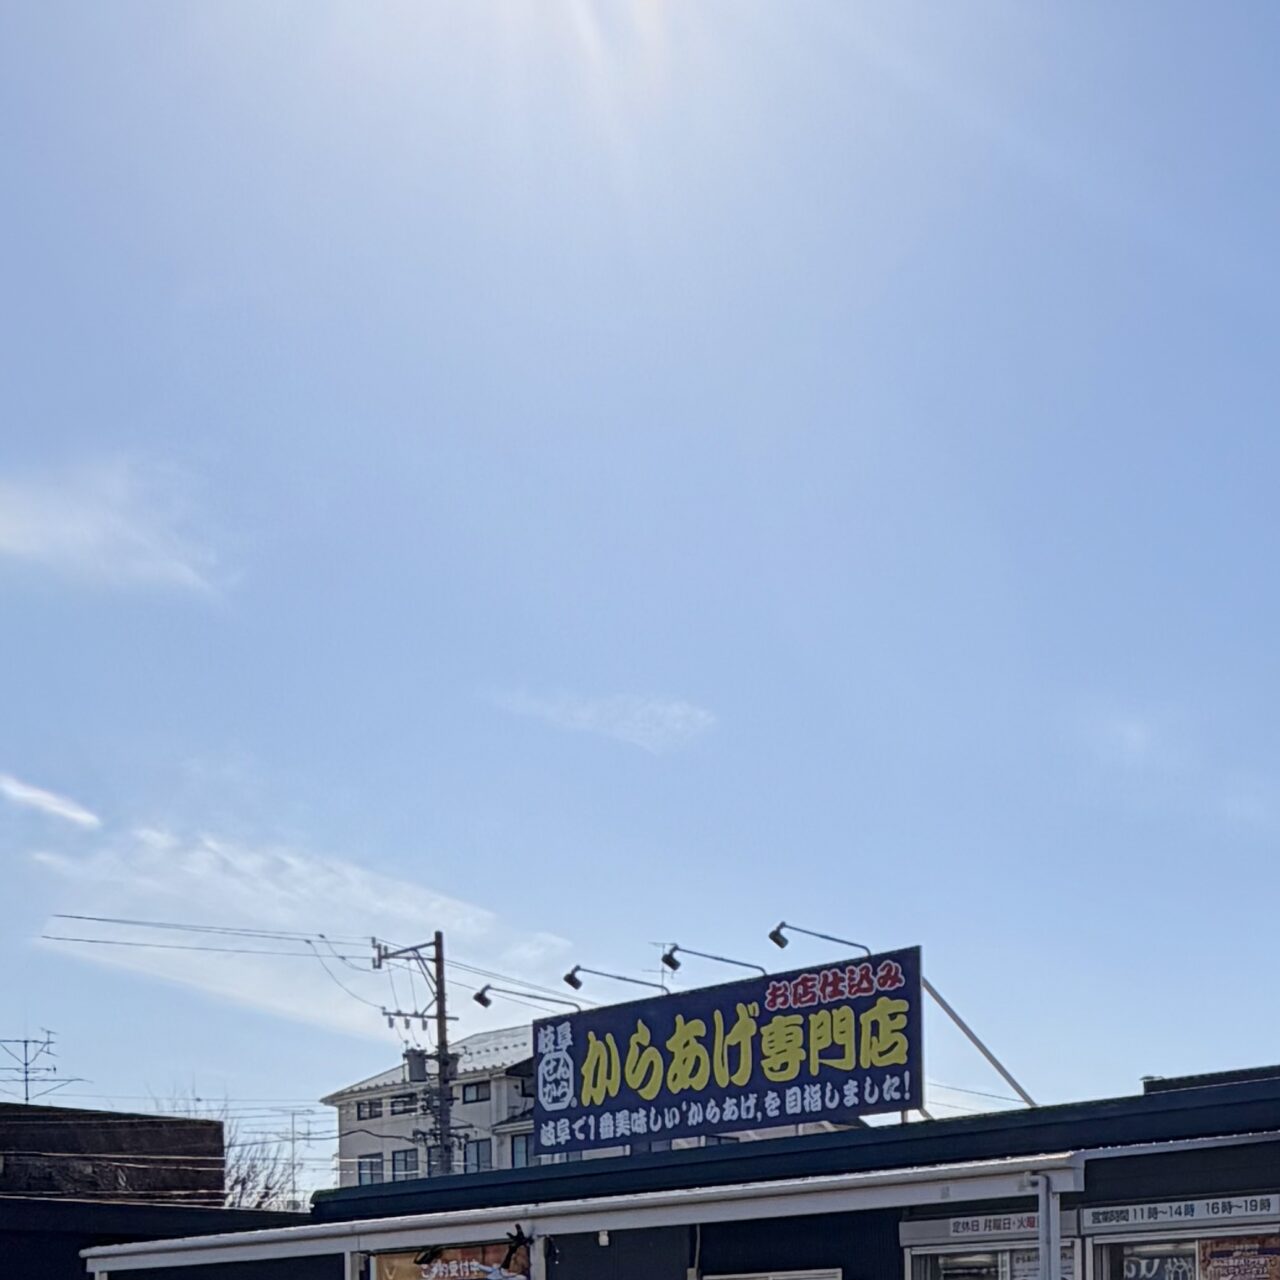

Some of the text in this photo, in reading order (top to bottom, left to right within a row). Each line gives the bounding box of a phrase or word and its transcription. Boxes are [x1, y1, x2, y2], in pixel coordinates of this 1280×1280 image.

[765, 959, 905, 1012] お店仕込み
[581, 996, 910, 1107] からあげ専門店
